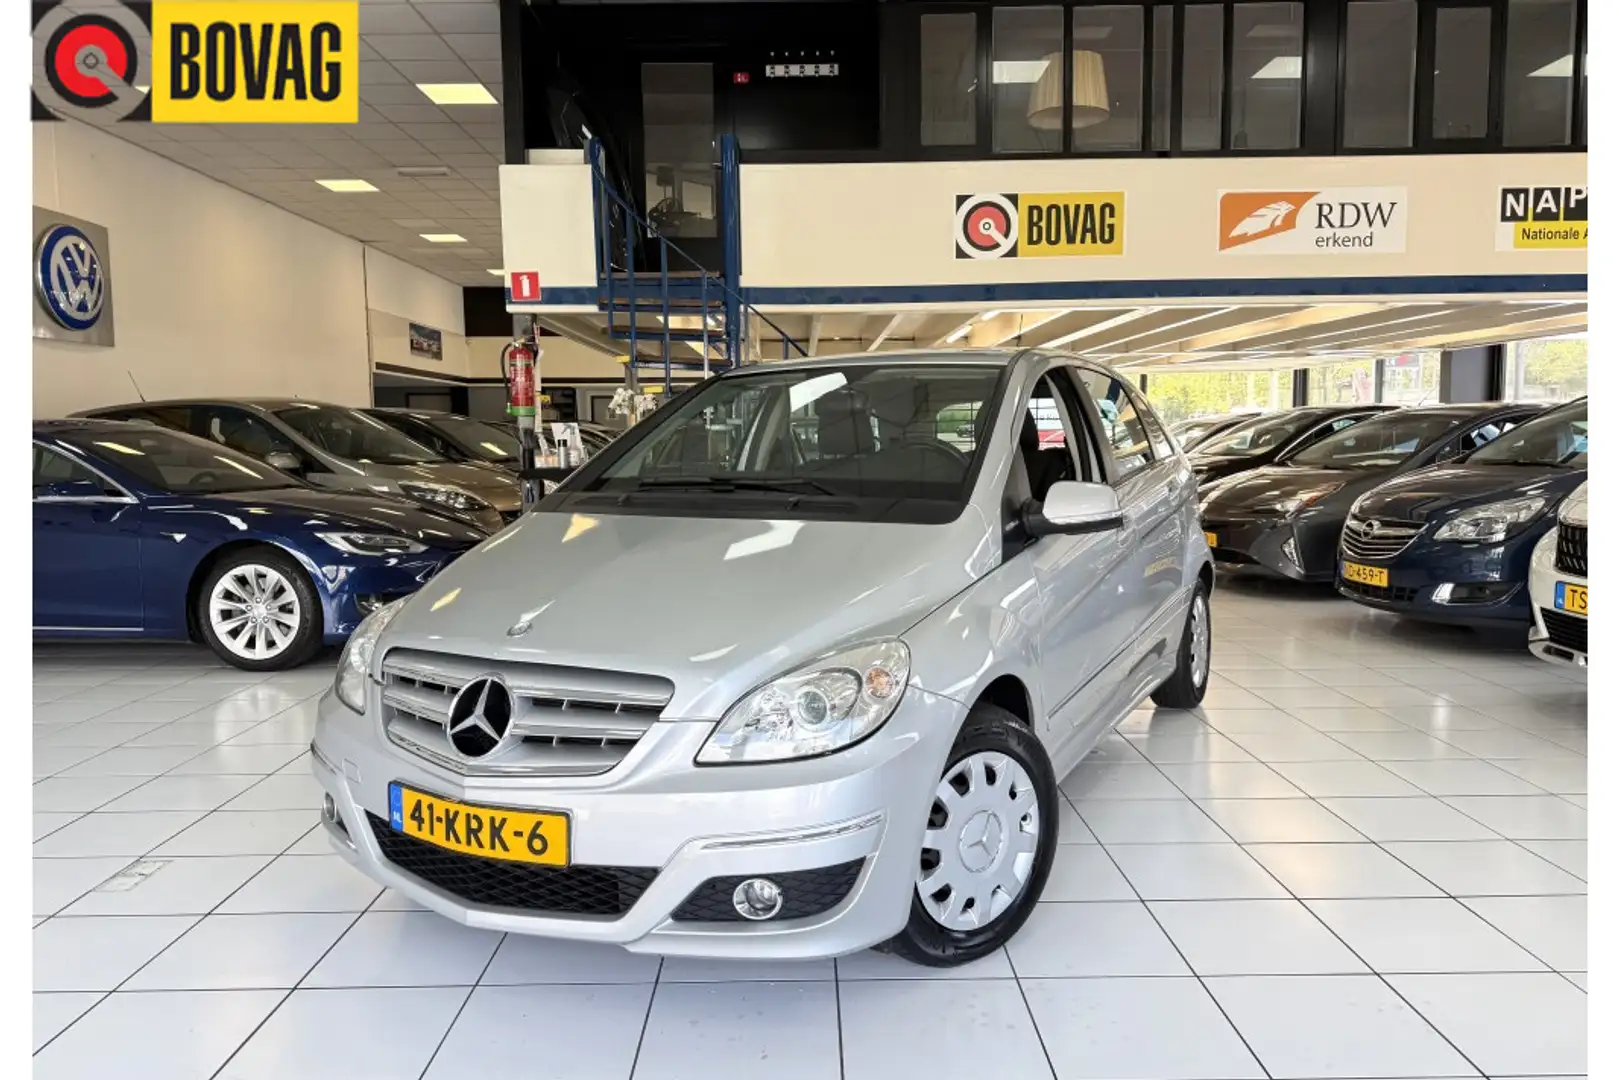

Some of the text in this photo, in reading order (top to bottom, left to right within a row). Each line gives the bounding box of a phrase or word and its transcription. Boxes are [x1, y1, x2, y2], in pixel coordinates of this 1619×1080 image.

[1314, 202, 1397, 229] RDW
[1505, 187, 1587, 217] NAP
[1027, 202, 1115, 246] BOVAG
[1521, 227, 1580, 240] Nationale
[1315, 231, 1373, 248] erkend
[410, 799, 548, 856] 41-KRK-6
